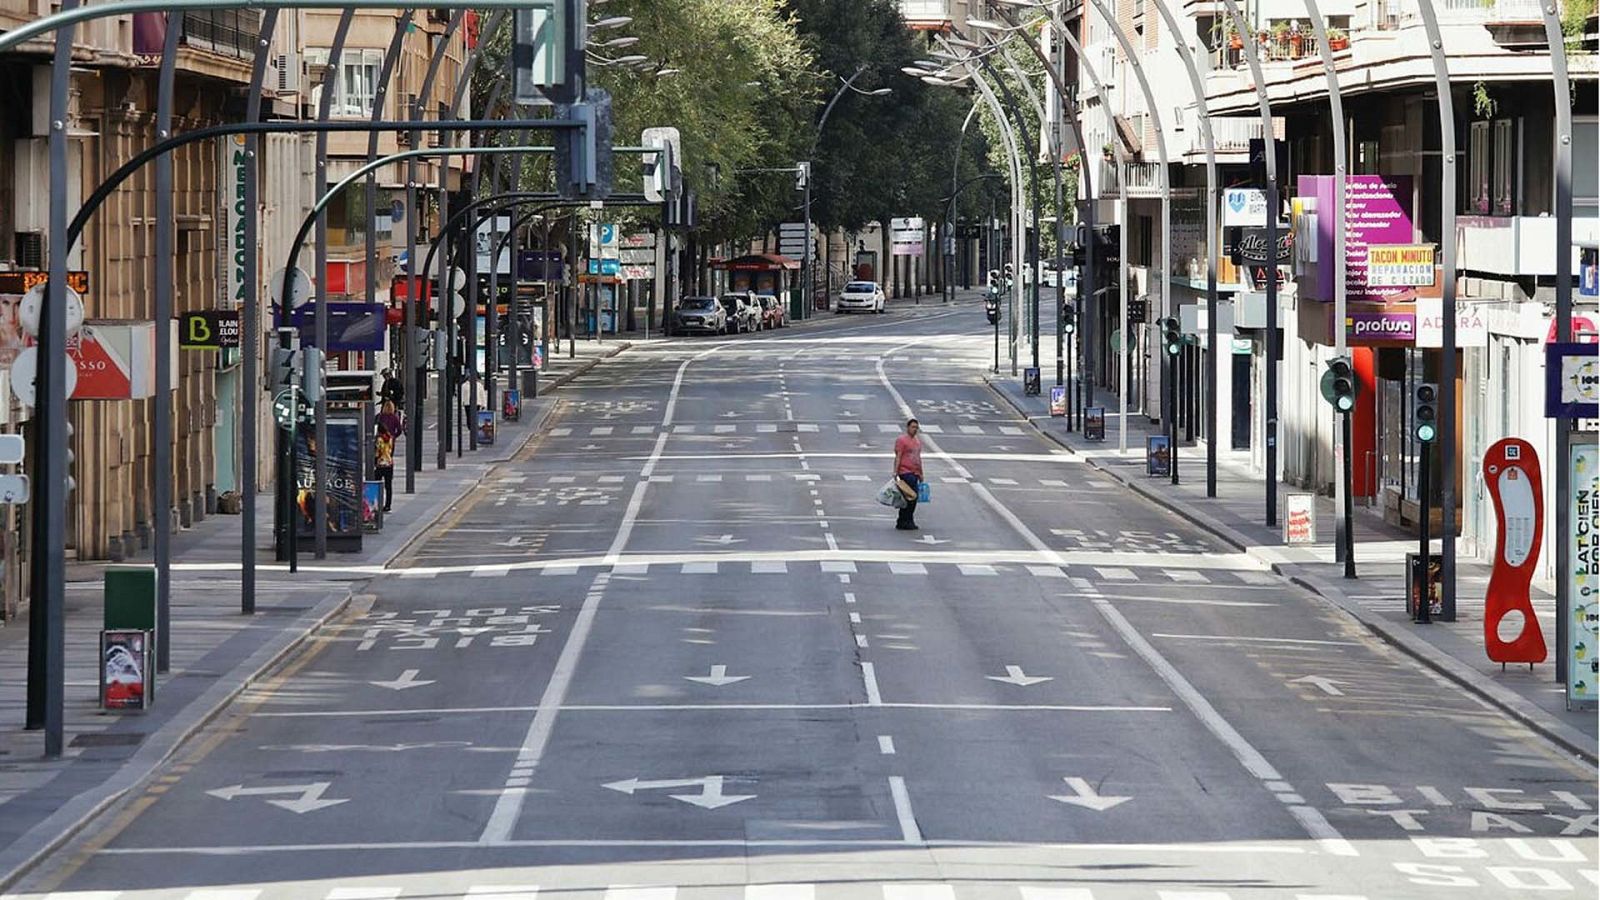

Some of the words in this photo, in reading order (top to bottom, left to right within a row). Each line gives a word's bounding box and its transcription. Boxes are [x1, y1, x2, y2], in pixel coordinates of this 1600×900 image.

[1370, 250, 1397, 262] TACON
[1401, 250, 1432, 262] MINUTO
[190, 316, 210, 341] B
[1356, 318, 1412, 334] profusa
[1422, 317, 1482, 328] ADRA
[1325, 783, 1592, 810] BICI
[1392, 862, 1598, 890] SO
